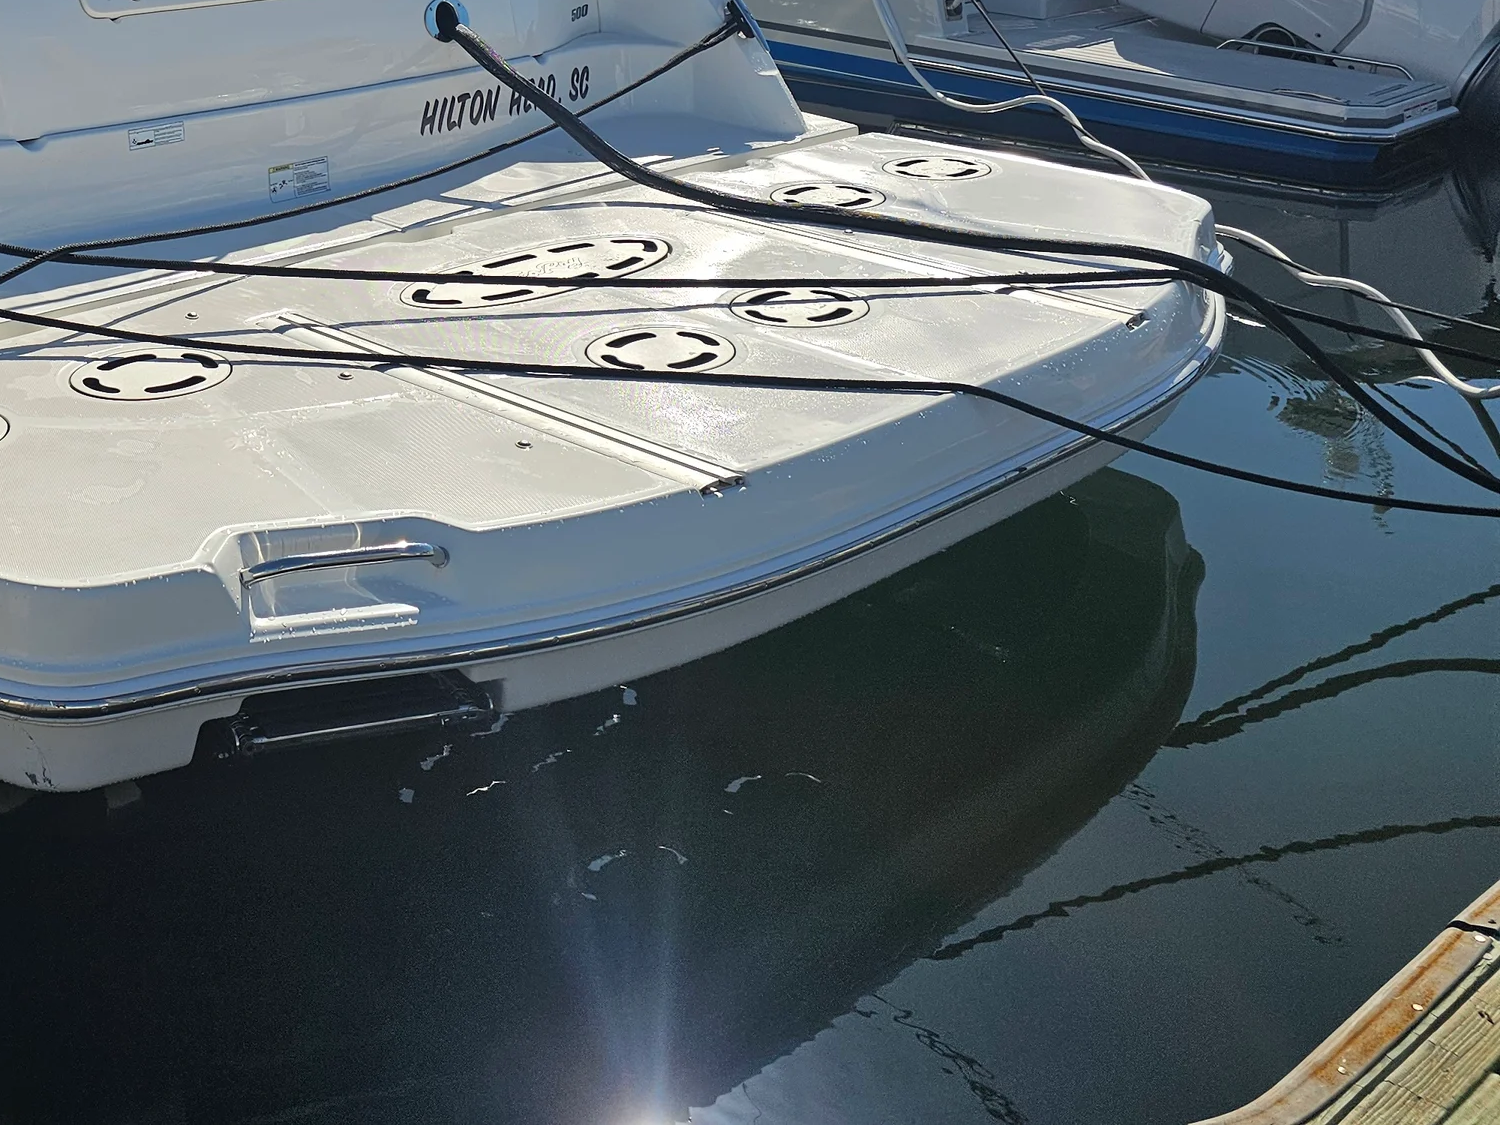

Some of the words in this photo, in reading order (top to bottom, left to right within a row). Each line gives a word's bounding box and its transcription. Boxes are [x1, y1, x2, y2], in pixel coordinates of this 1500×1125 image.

[571, 3, 589, 22] 500
[420, 84, 501, 137] HILTON
[568, 65, 590, 102] SC
